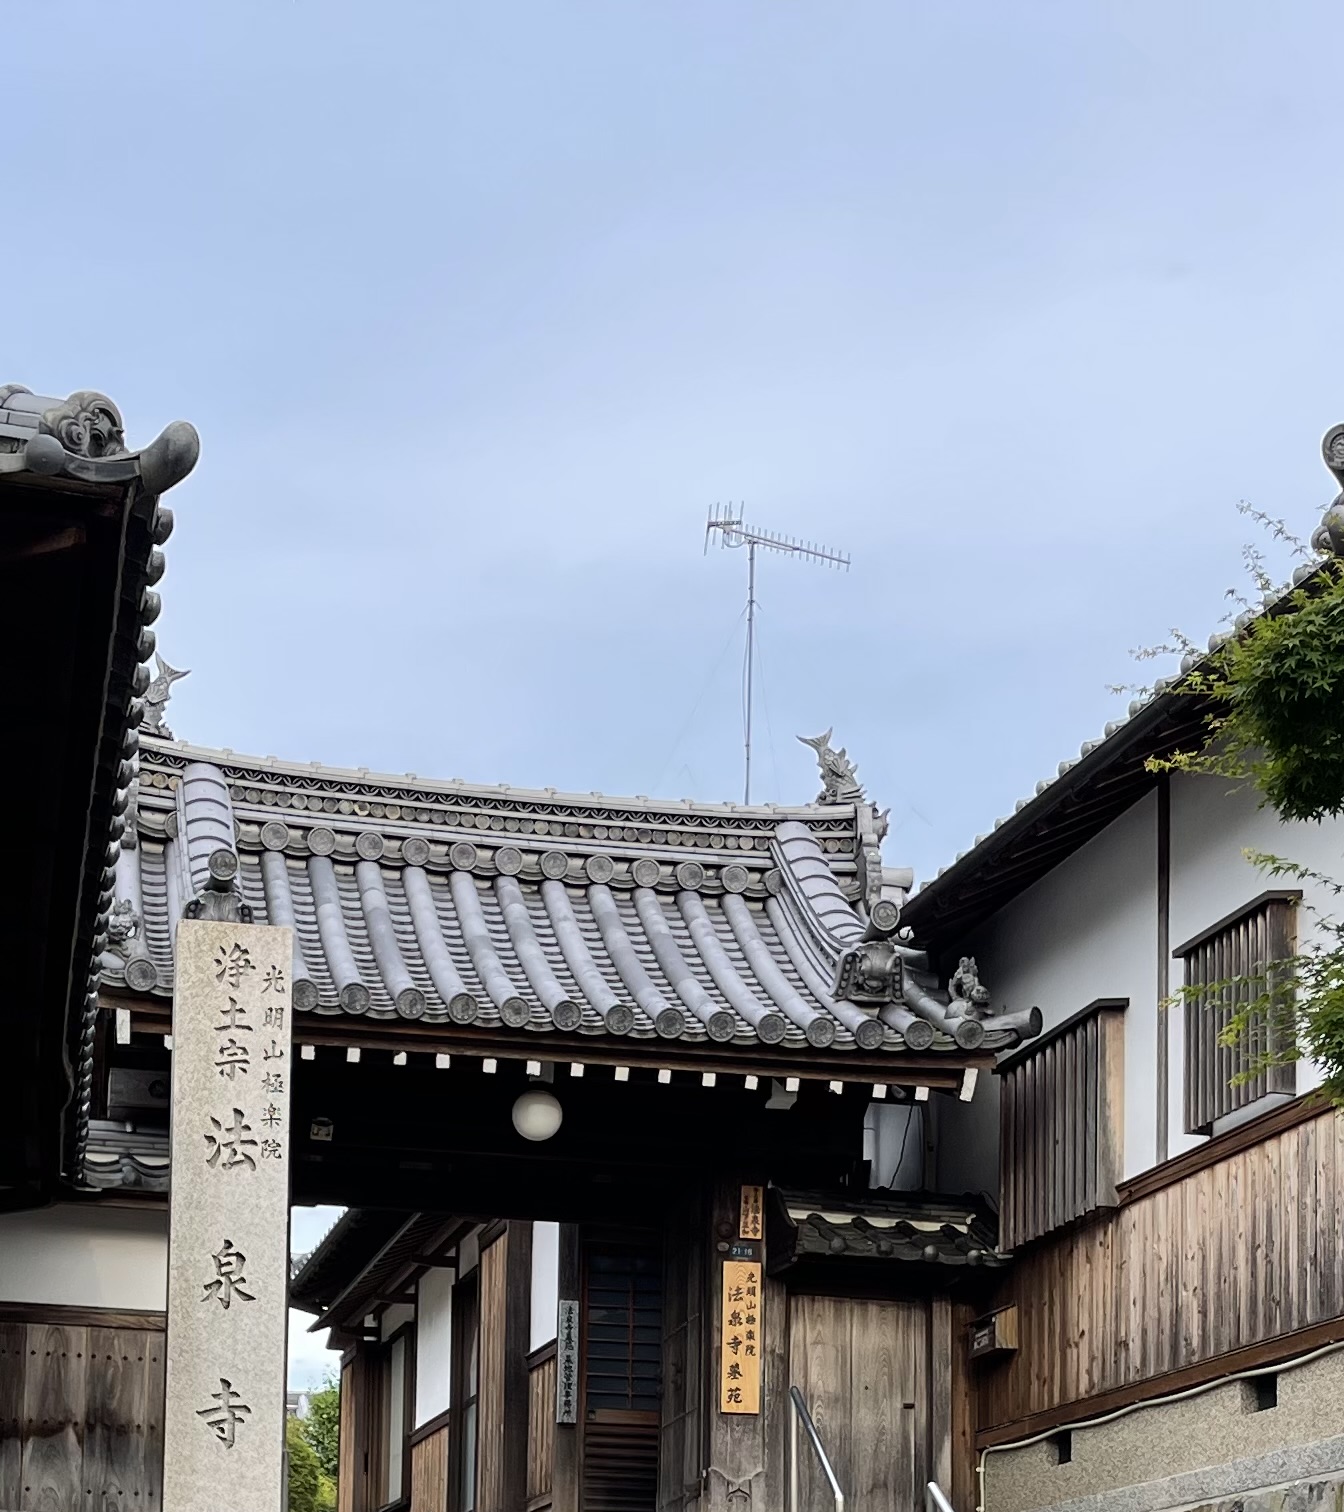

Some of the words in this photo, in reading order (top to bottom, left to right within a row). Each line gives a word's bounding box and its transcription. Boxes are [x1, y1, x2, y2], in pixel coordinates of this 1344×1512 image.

[259, 964, 286, 1161] 光明山極楽院
[726, 1285, 744, 1404] 法泉寺墓苑
